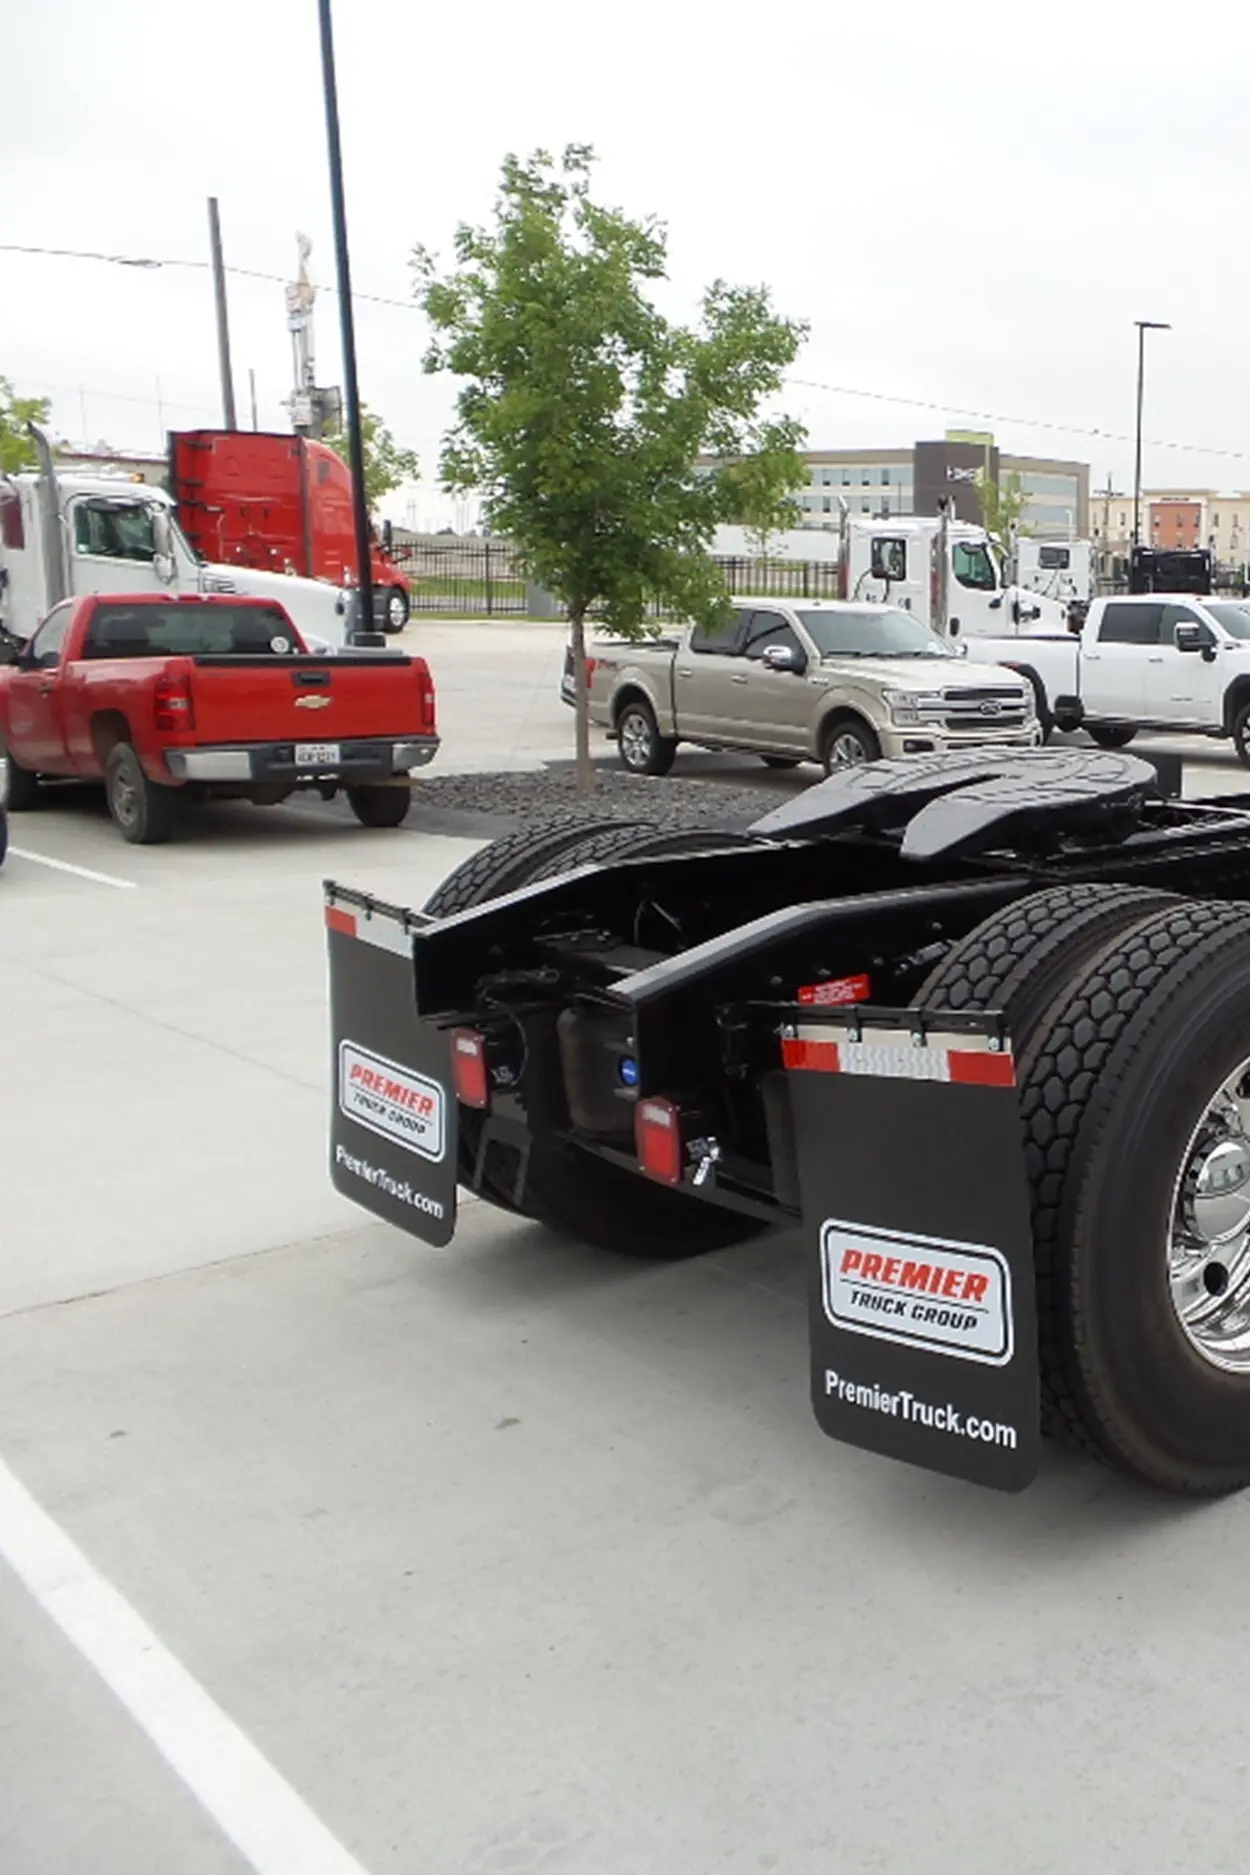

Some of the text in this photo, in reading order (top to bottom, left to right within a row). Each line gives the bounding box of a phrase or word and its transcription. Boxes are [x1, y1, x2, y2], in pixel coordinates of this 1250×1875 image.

[349, 1063, 434, 1117] PREMIER
[353, 1092, 427, 1135] TRUCK GROUP
[335, 1143, 445, 1220] PremierTruck.com
[840, 1248, 990, 1303] PREMIER
[850, 1289, 978, 1332] TRUCK GROUP
[825, 1369, 1017, 1449] PremierTruck.com
